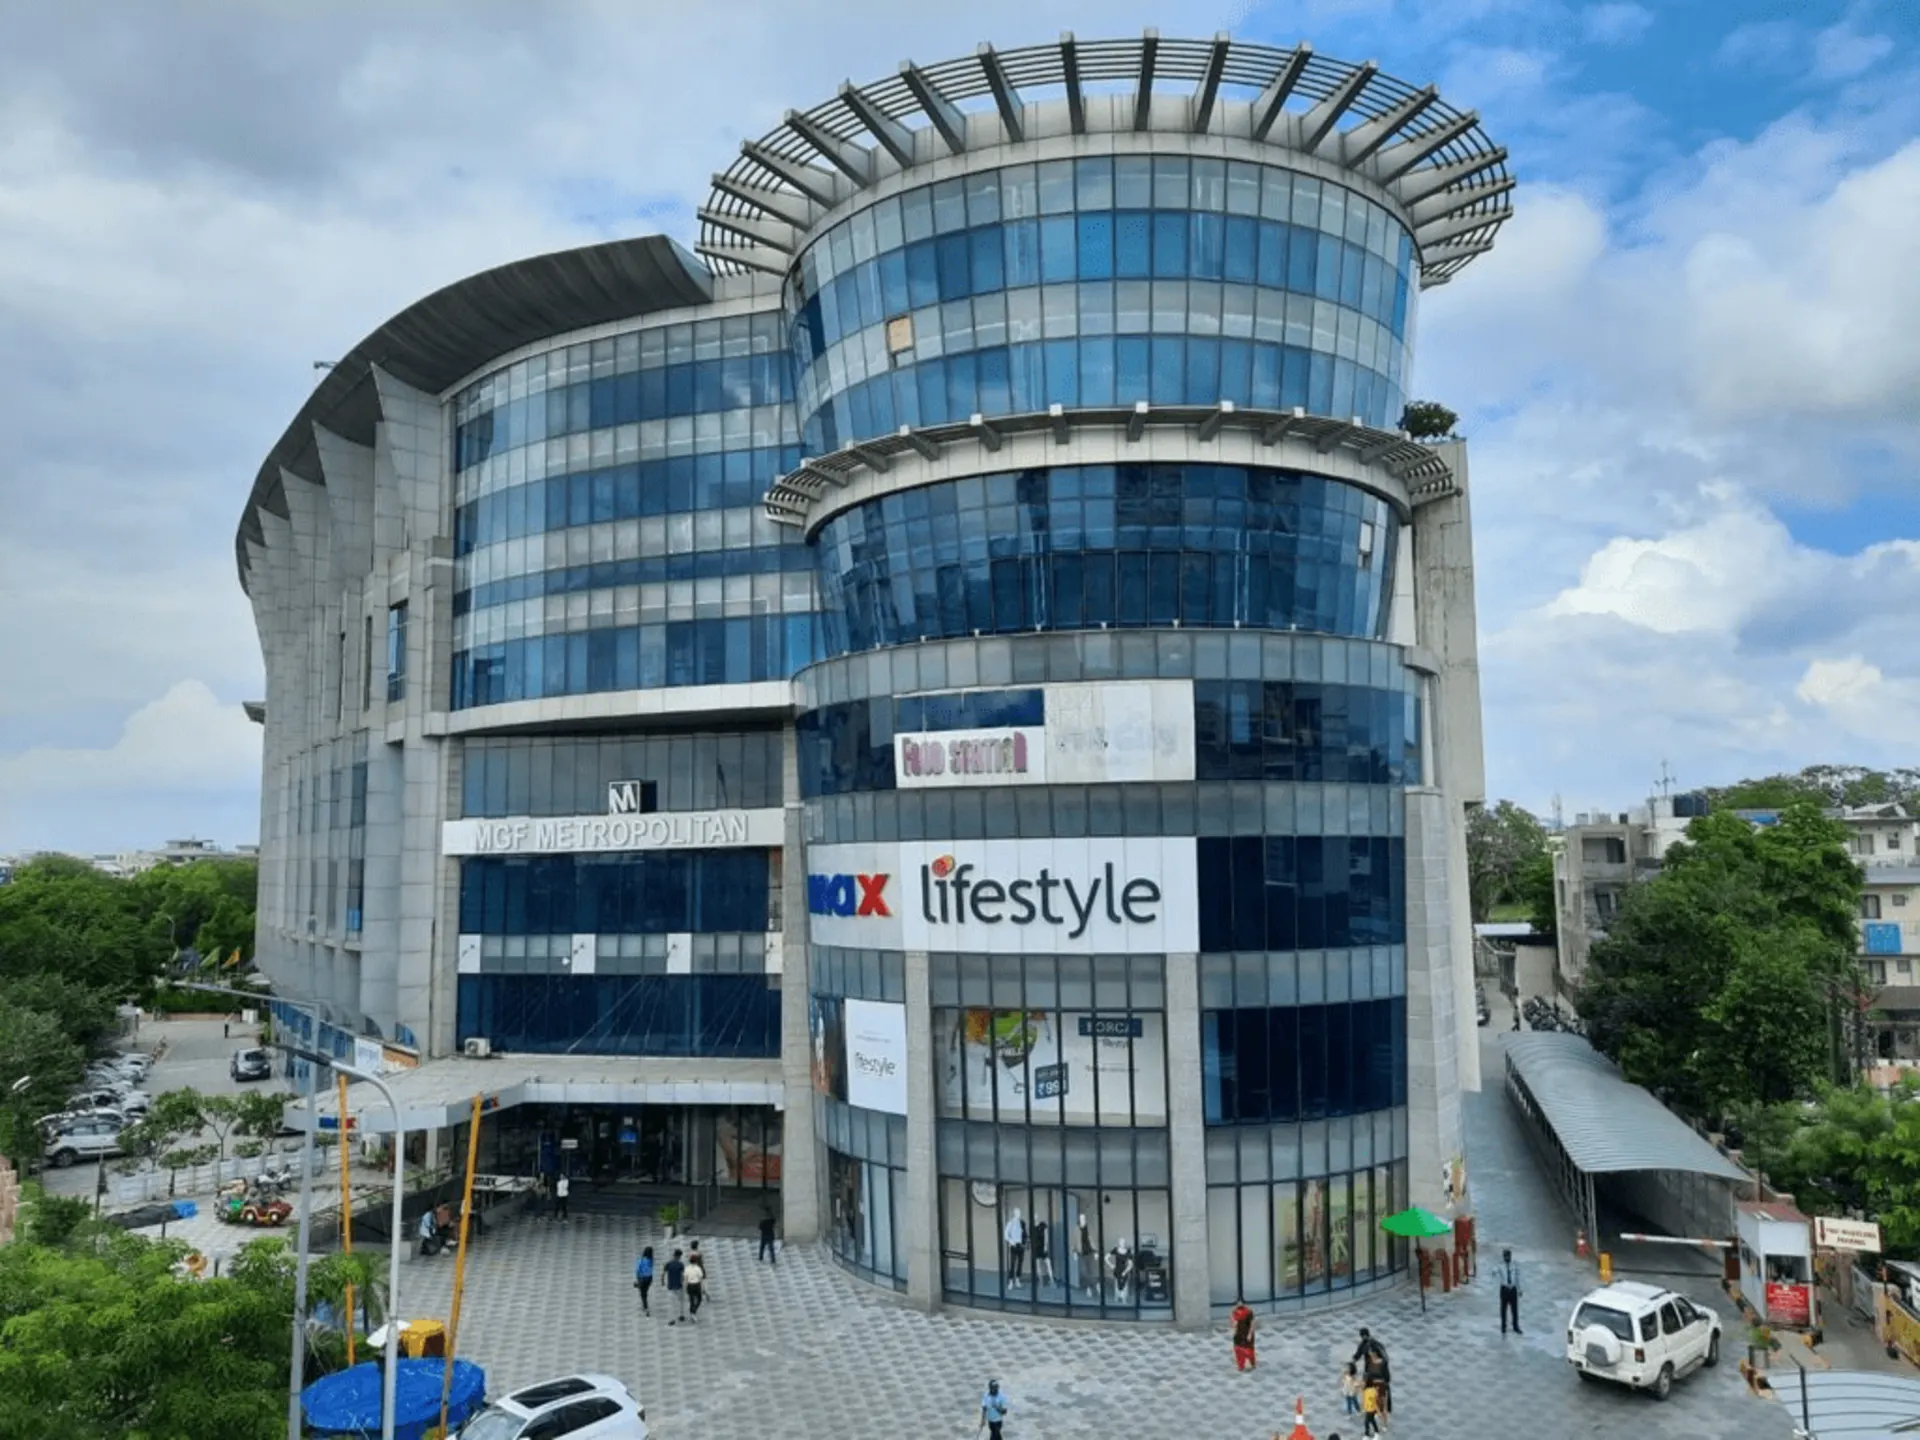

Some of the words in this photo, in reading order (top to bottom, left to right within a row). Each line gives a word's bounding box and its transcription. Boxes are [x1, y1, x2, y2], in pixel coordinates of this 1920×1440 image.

[610, 784, 637, 813] M
[473, 822, 529, 851] MGF
[535, 815, 750, 850] METROPOLITAN
[921, 855, 1161, 939] lifestyle
